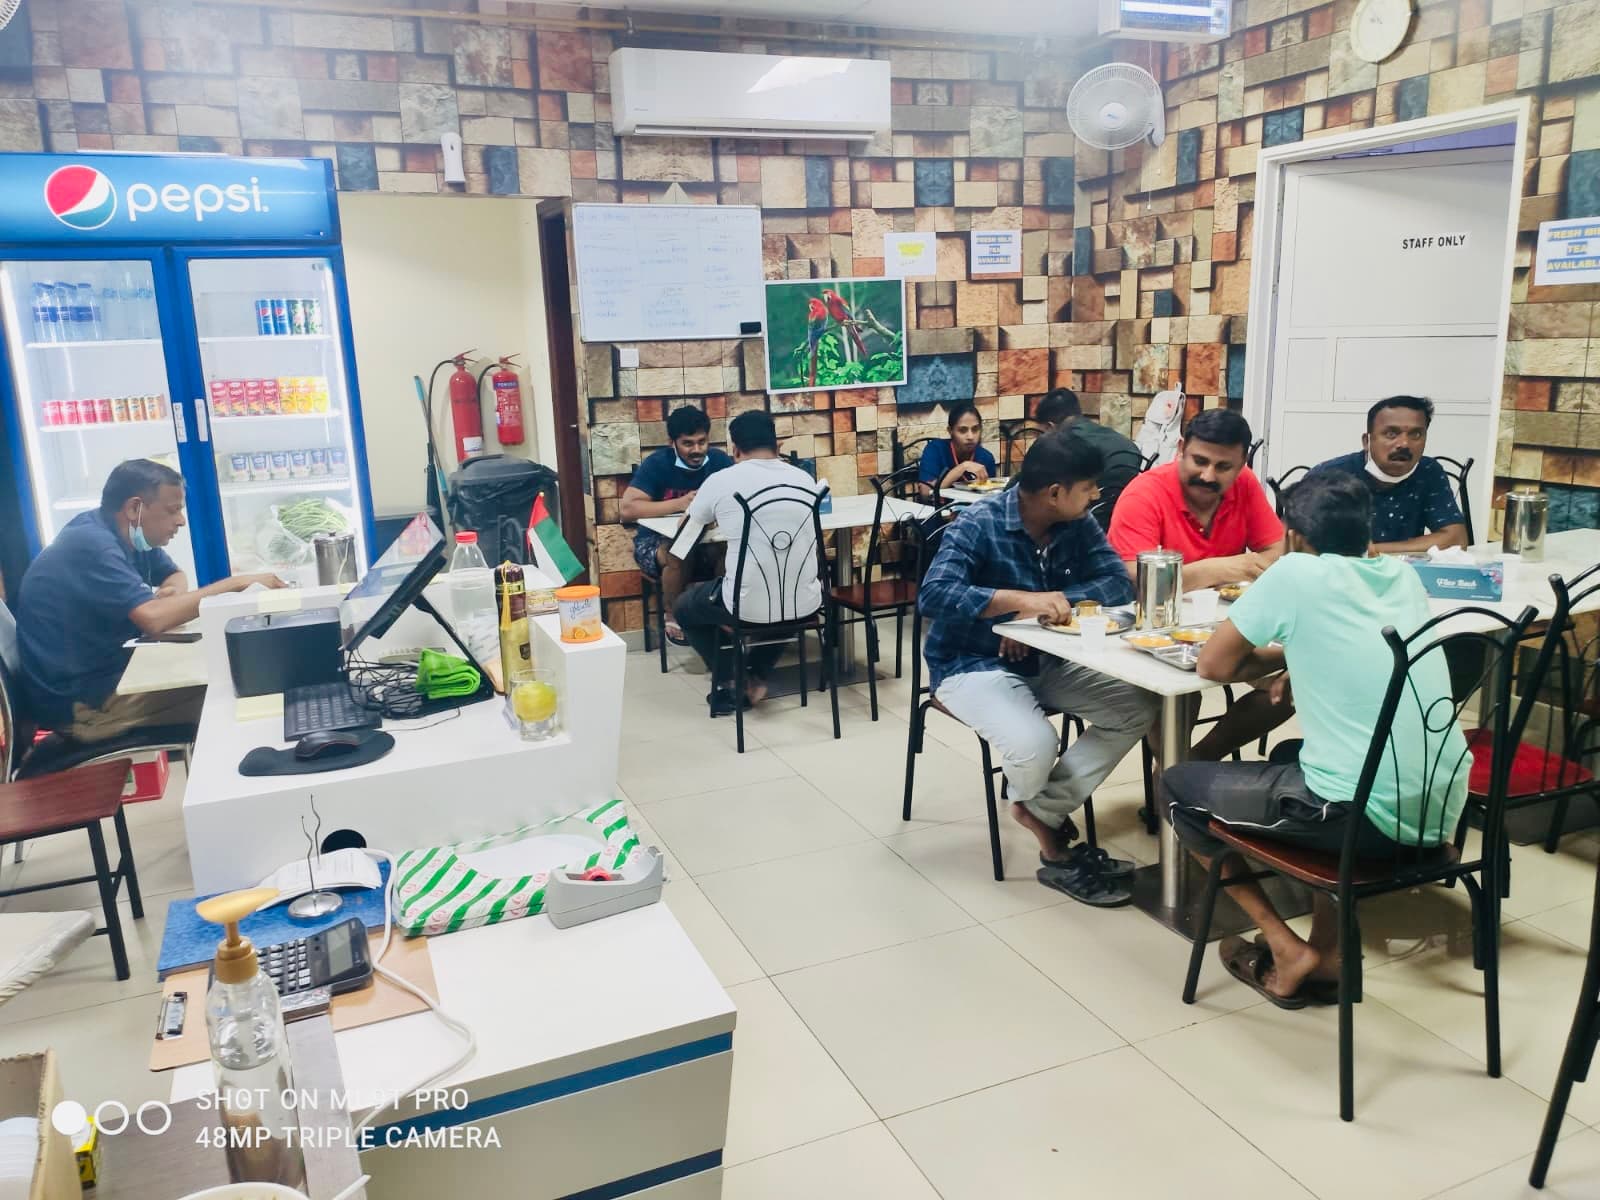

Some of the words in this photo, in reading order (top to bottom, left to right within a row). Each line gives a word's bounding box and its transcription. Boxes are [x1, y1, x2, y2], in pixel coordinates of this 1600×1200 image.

[1402, 237, 1434, 250] STAFF
[1437, 234, 1466, 247] ONLY
[1568, 243, 1587, 254] TEA
